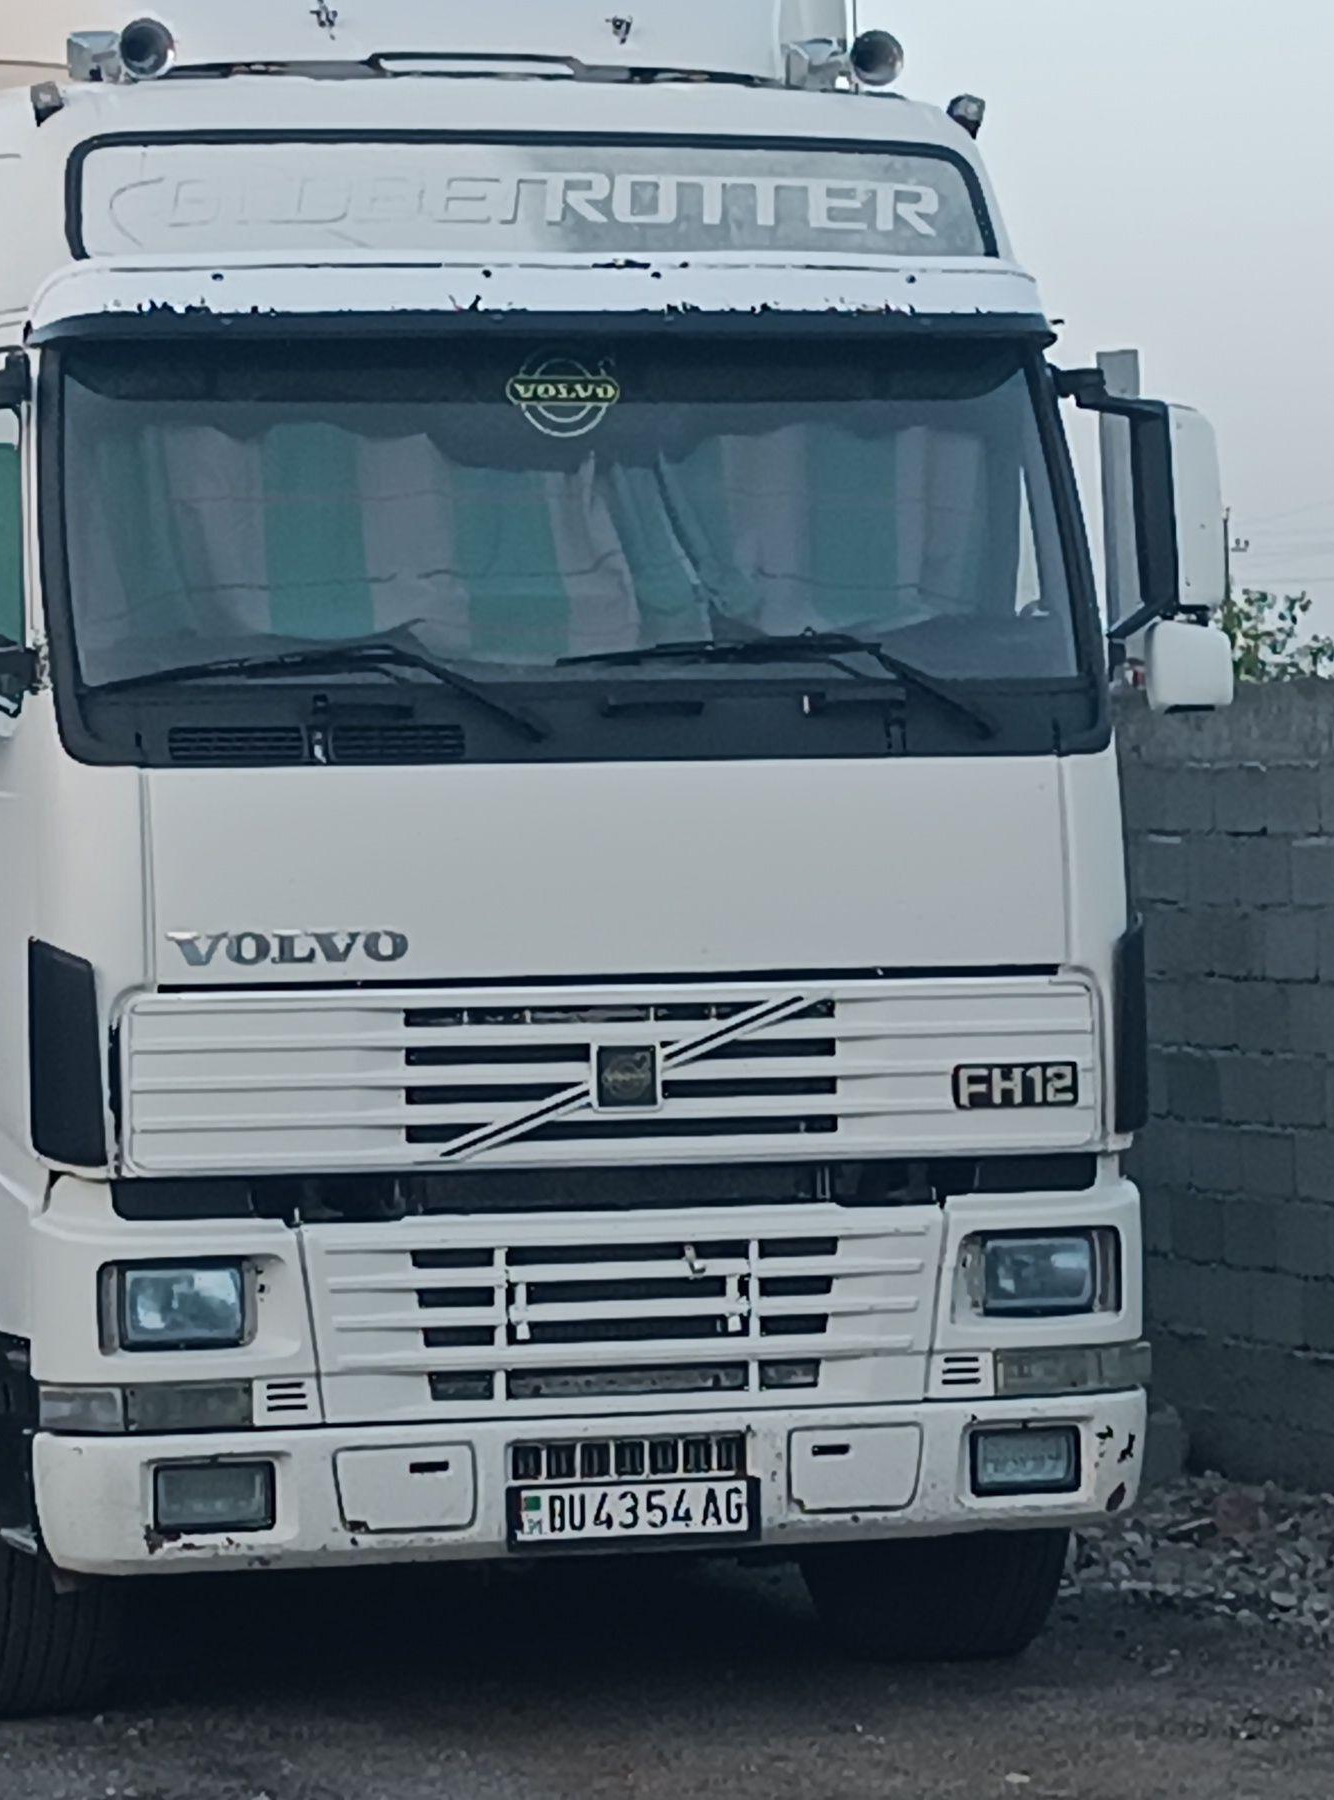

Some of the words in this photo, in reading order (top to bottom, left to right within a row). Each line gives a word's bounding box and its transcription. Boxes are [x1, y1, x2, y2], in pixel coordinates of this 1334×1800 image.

[513, 383, 616, 399] VOLVO
[166, 929, 409, 967] VOLVO
[958, 1065, 1075, 1107] FH12
